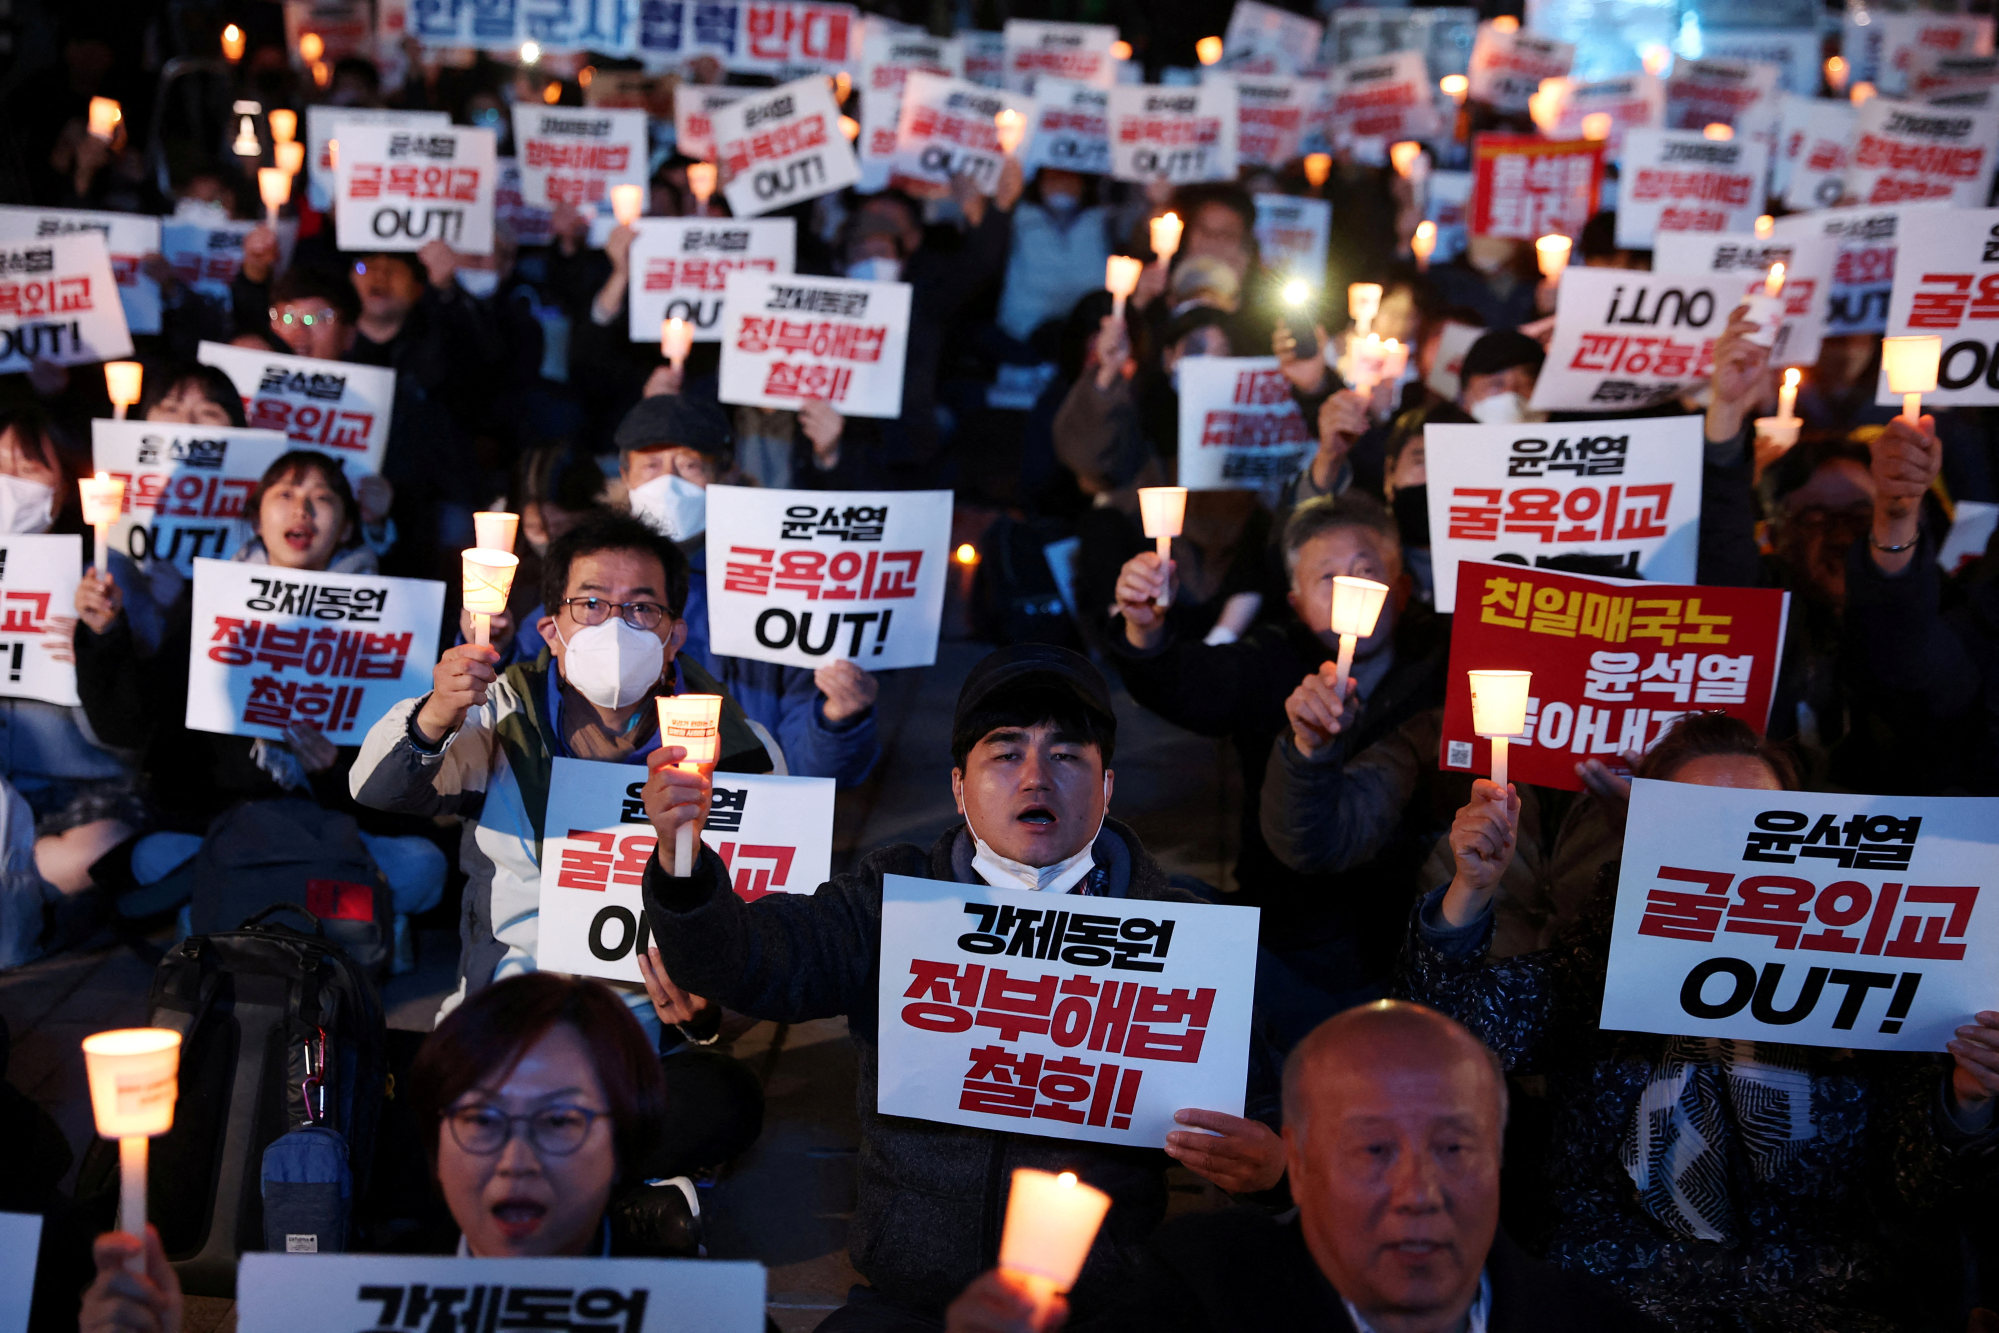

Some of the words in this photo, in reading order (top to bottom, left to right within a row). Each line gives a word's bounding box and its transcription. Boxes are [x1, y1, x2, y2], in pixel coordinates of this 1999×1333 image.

[1507, 435, 1629, 477] 윤석열
[781, 505, 888, 541] 윤석열
[1447, 482, 1675, 543] 굴욕외교
[246, 578, 388, 622] 강제동원
[724, 546, 924, 600] 굴욕외교
[755, 608, 893, 658] OUT!
[1480, 577, 1733, 646] 친일매국노
[208, 616, 413, 679] 정부해법
[1583, 651, 1754, 704] 윤석열
[242, 676, 364, 731] 철회!
[620, 782, 748, 832] 윤열
[558, 829, 796, 903] 굴욕교
[1742, 810, 1922, 871] 윤석열
[957, 902, 1175, 973] 강제동원
[1637, 865, 1980, 960] 굴욕외교
[900, 958, 1217, 1063] 정부해법
[1679, 957, 1922, 1034] OUT!
[958, 1044, 1143, 1130] 철회!
